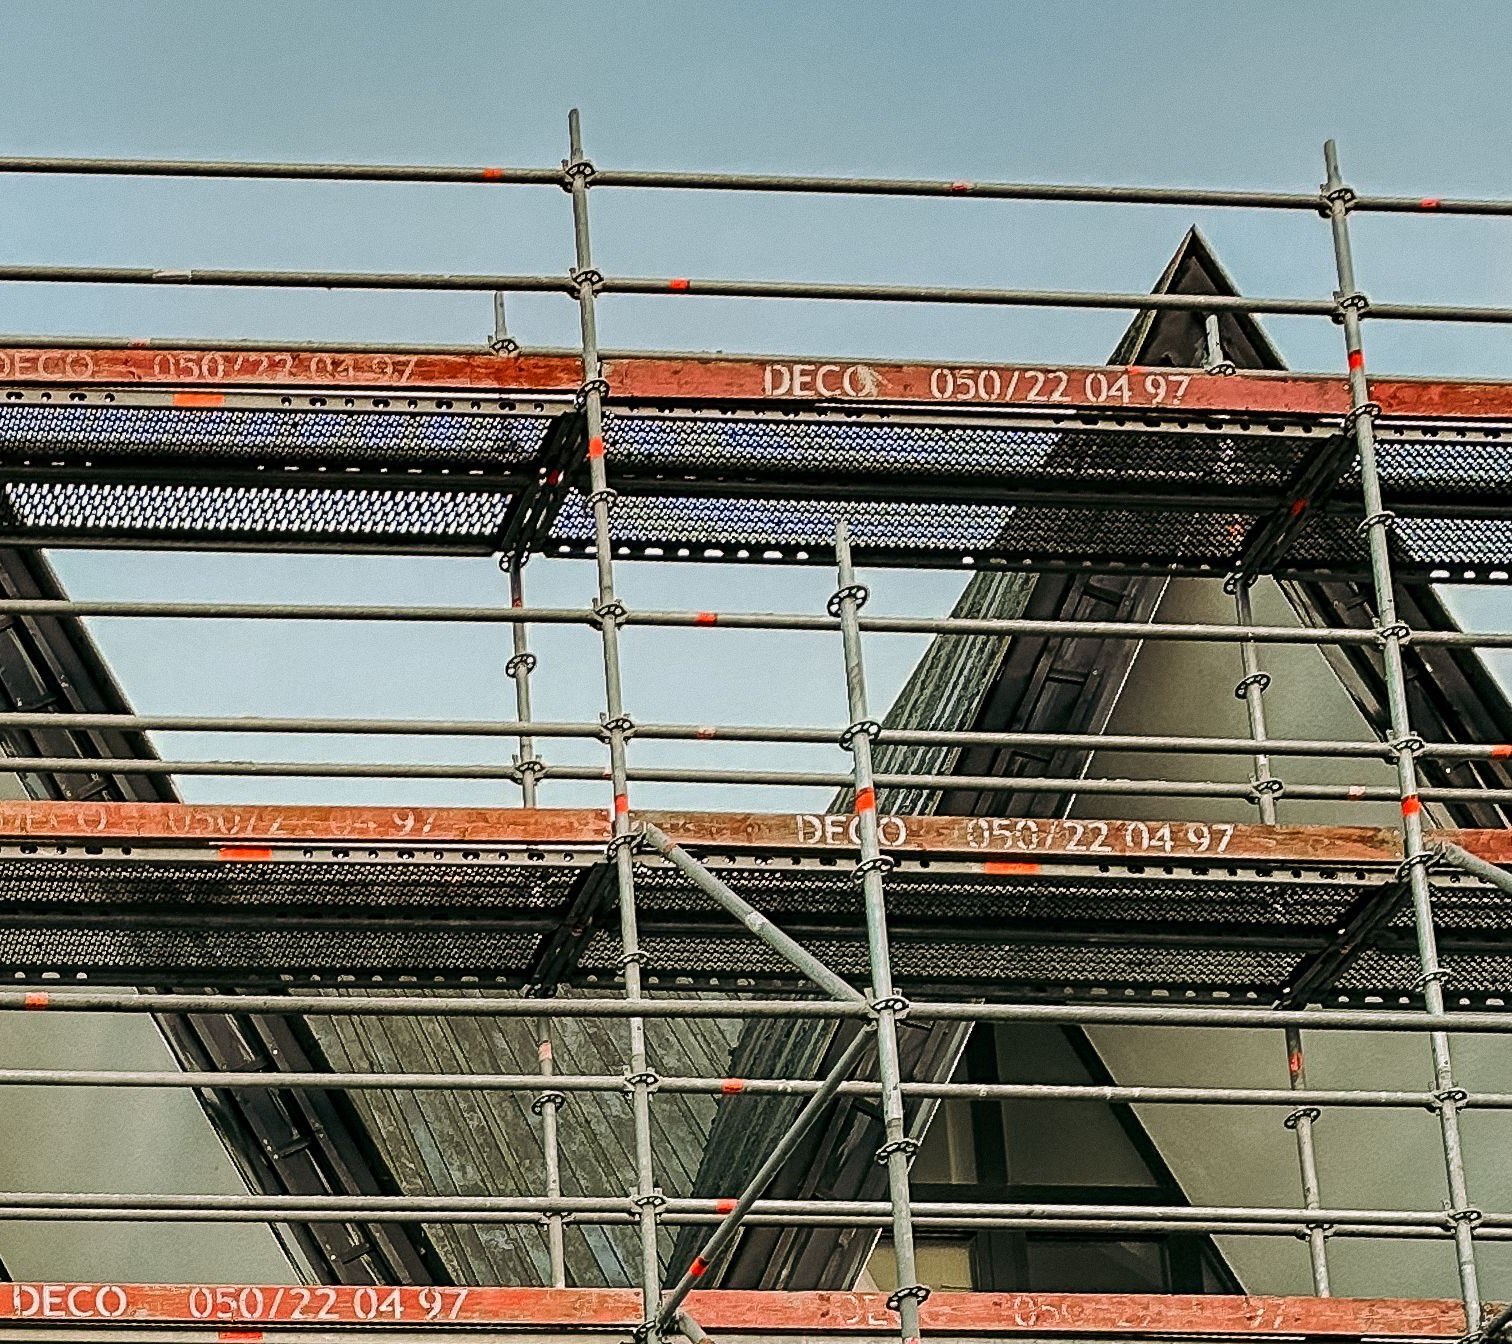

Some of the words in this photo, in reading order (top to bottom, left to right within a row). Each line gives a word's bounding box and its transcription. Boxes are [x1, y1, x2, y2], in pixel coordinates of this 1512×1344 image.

[764, 365, 870, 397] DECO
[930, 369, 1071, 402] 050/22
[1085, 372, 1131, 404] 04
[1145, 374, 1192, 405] 97
[968, 819, 1113, 852] 050/22
[1125, 822, 1173, 853] 04
[1189, 824, 1236, 854] 97
[12, 1286, 127, 1318] DECO
[189, 1287, 340, 1320] 050/22
[354, 1289, 404, 1320] 04
[419, 1289, 468, 1320] 97
